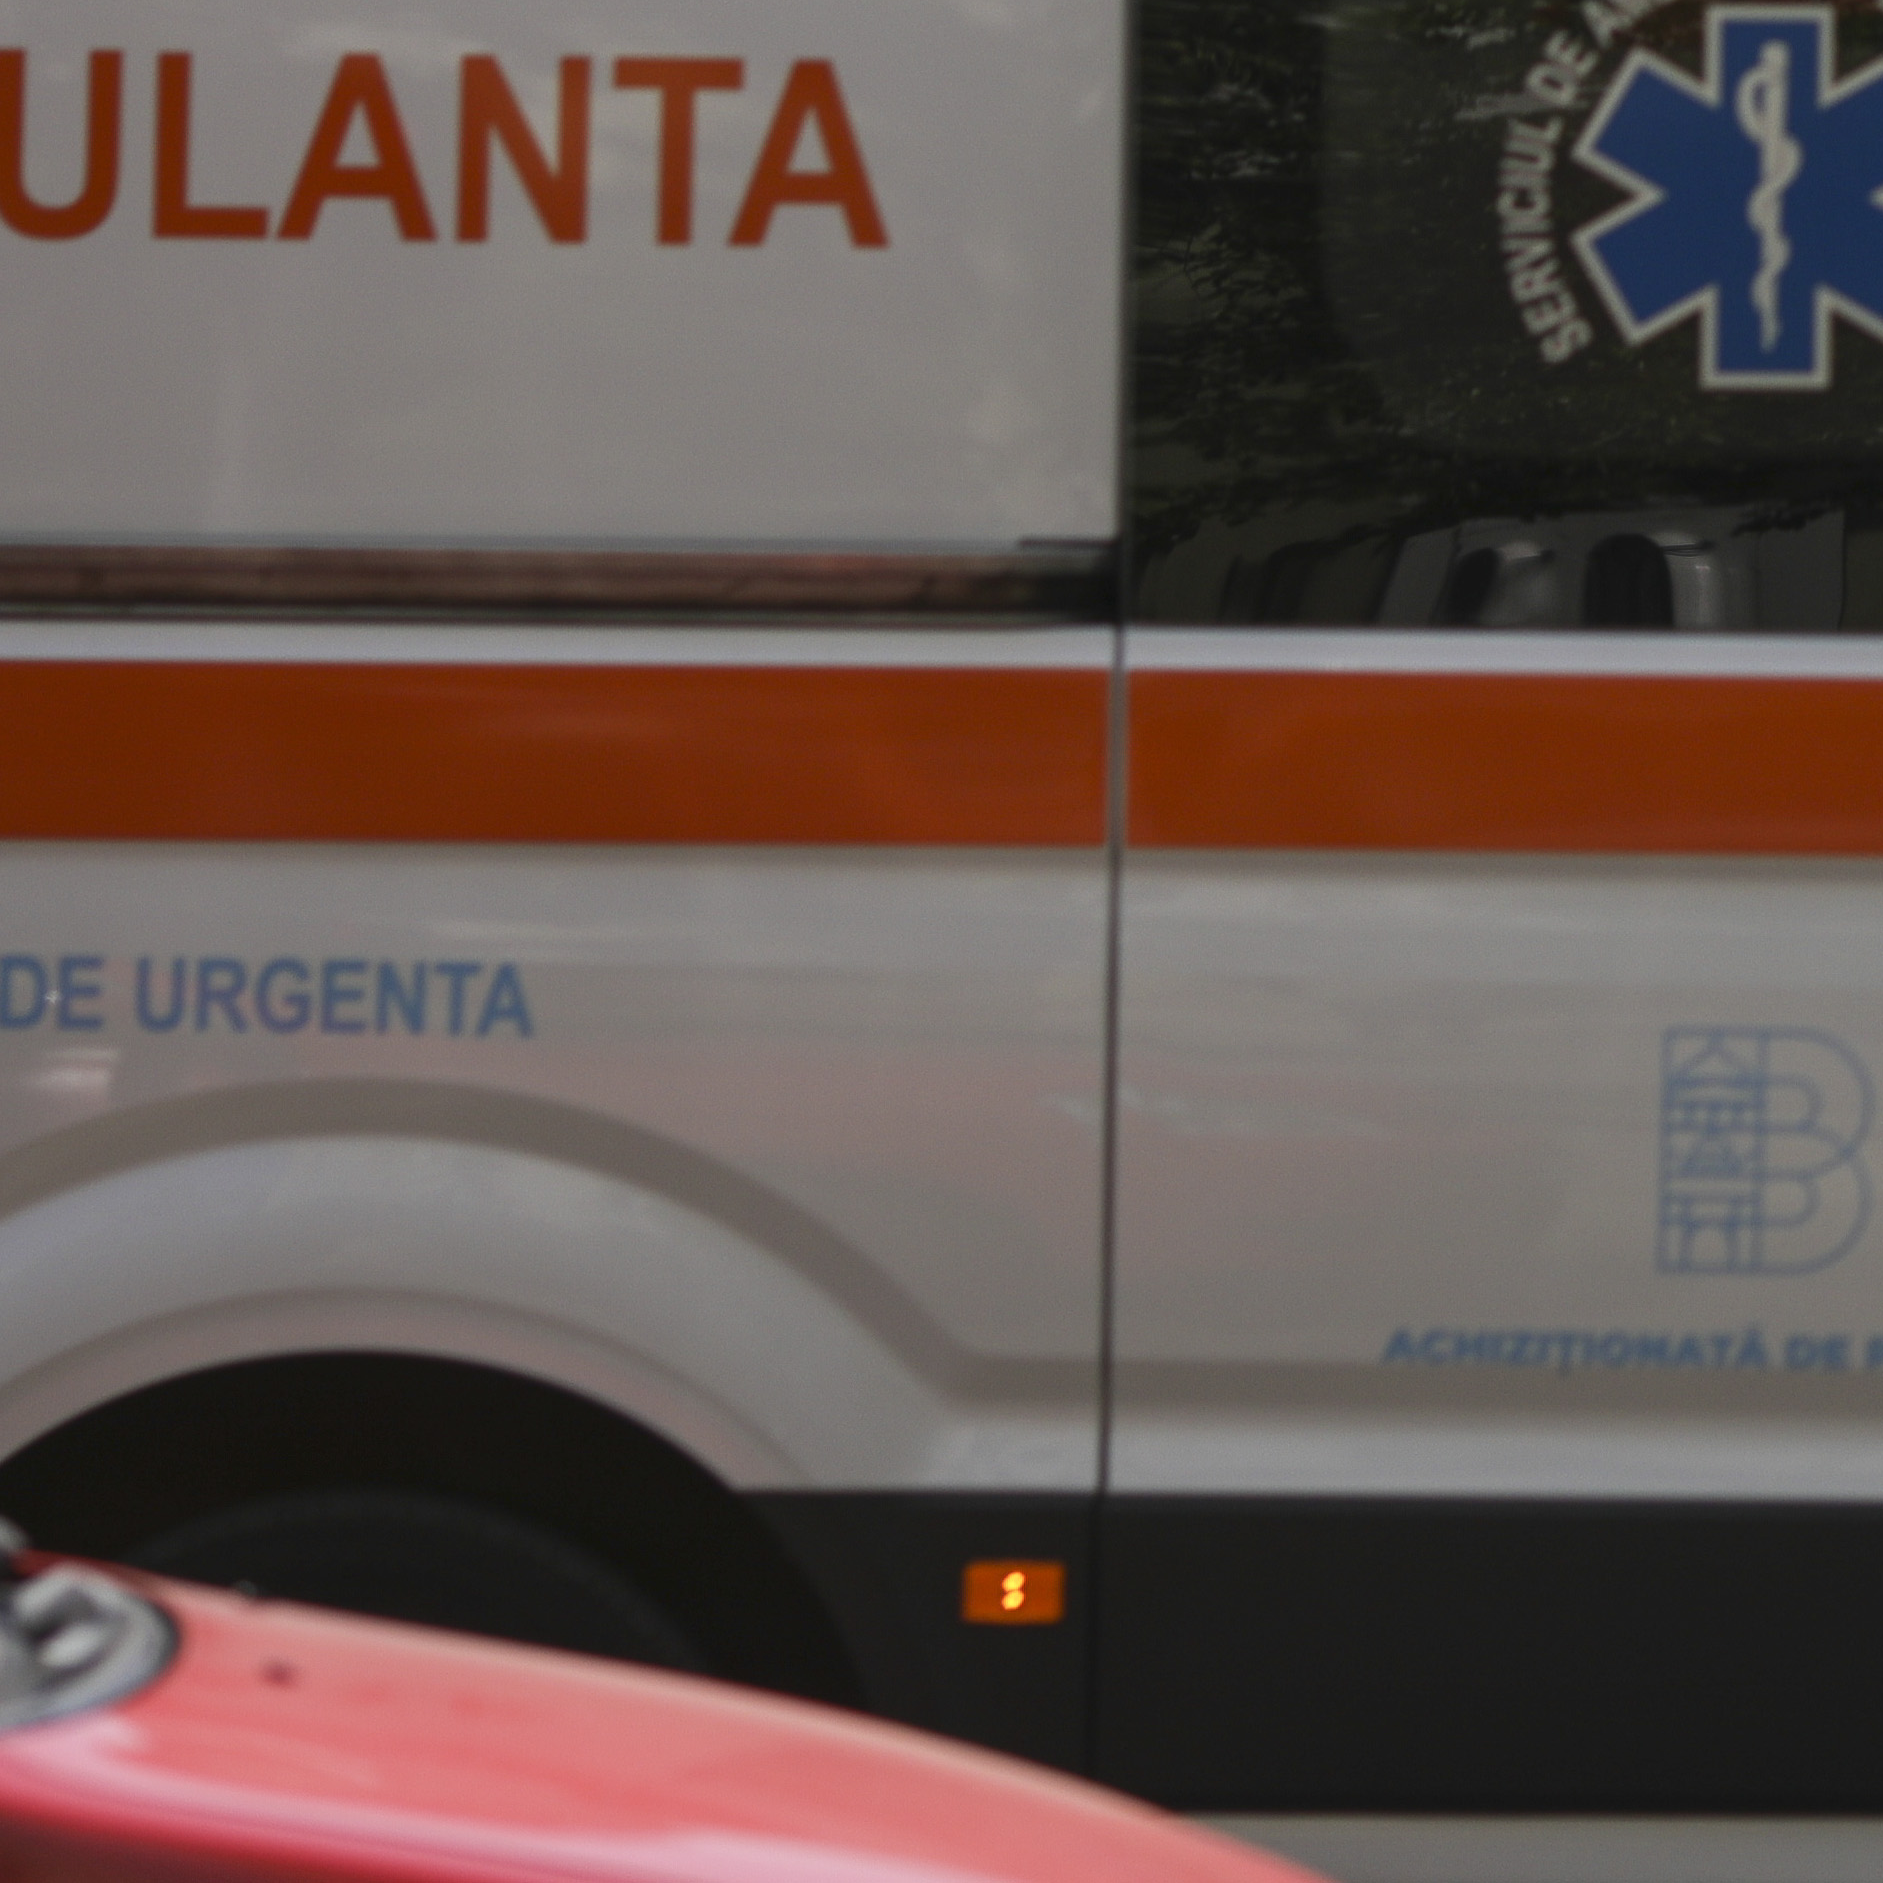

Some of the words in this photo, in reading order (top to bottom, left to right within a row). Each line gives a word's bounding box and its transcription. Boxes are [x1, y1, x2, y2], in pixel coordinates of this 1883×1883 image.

[1525, 28, 1599, 108] DE
[0, 45, 891, 250] ULANTA
[1498, 118, 1592, 364] SERVICIUL
[0, 953, 105, 1032] DE
[133, 955, 535, 1038] URGENTA
[1784, 1332, 1849, 1370] DE
